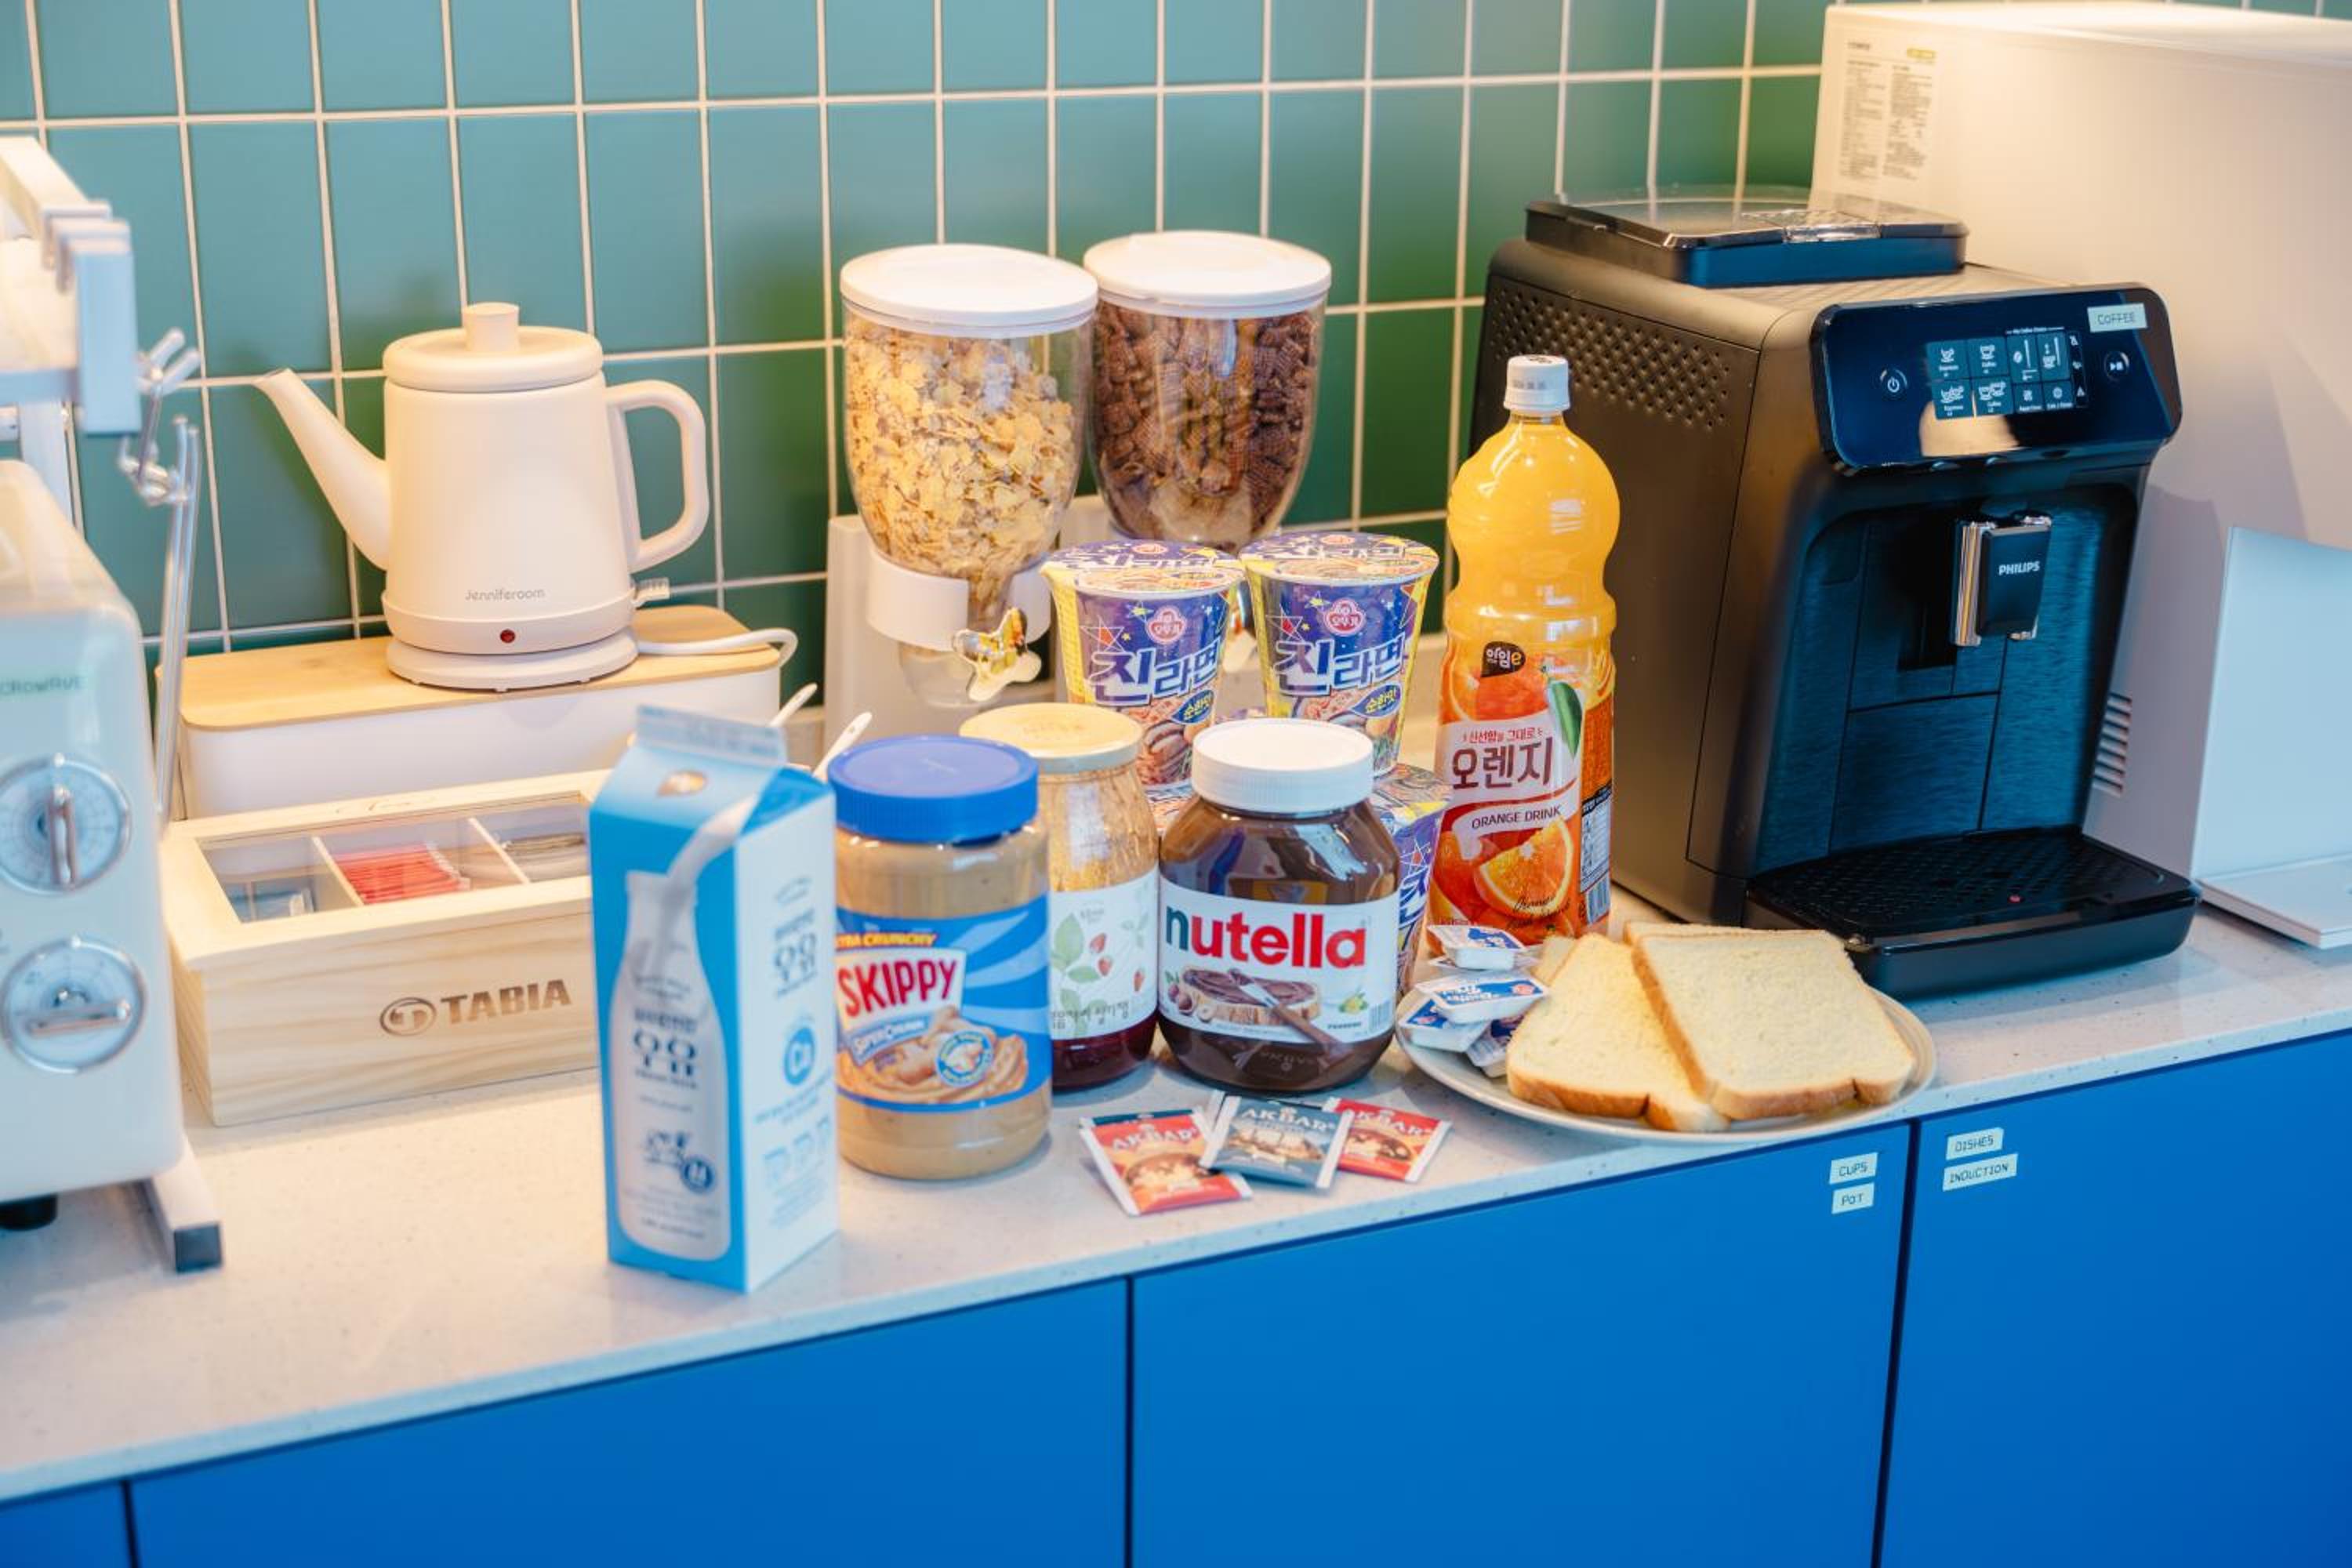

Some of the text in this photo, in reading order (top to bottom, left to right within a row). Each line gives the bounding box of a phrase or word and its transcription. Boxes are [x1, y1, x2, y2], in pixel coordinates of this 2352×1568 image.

[2097, 311, 2136, 325] COFFEE
[1998, 561, 2041, 575] PHILIPS
[464, 588, 546, 601] Jenniferoom
[1089, 637, 1221, 706] 진라면
[1273, 632, 1405, 696] 진라면
[1452, 736, 1553, 790] 오렌지
[1471, 804, 1562, 829] ORANGE DRINK
[1165, 905, 1367, 970] nutella
[837, 959, 956, 1018] SKIPPY
[440, 978, 572, 1025] TABIA
[1241, 1107, 1327, 1132] AKBAR
[1111, 1127, 1192, 1151] AKBAR
[1955, 1134, 1994, 1153] DISHES
[1838, 1161, 1868, 1177] CUPS
[1949, 1163, 2009, 1184] INDUCTION
[1841, 1192, 1865, 1207] POT
